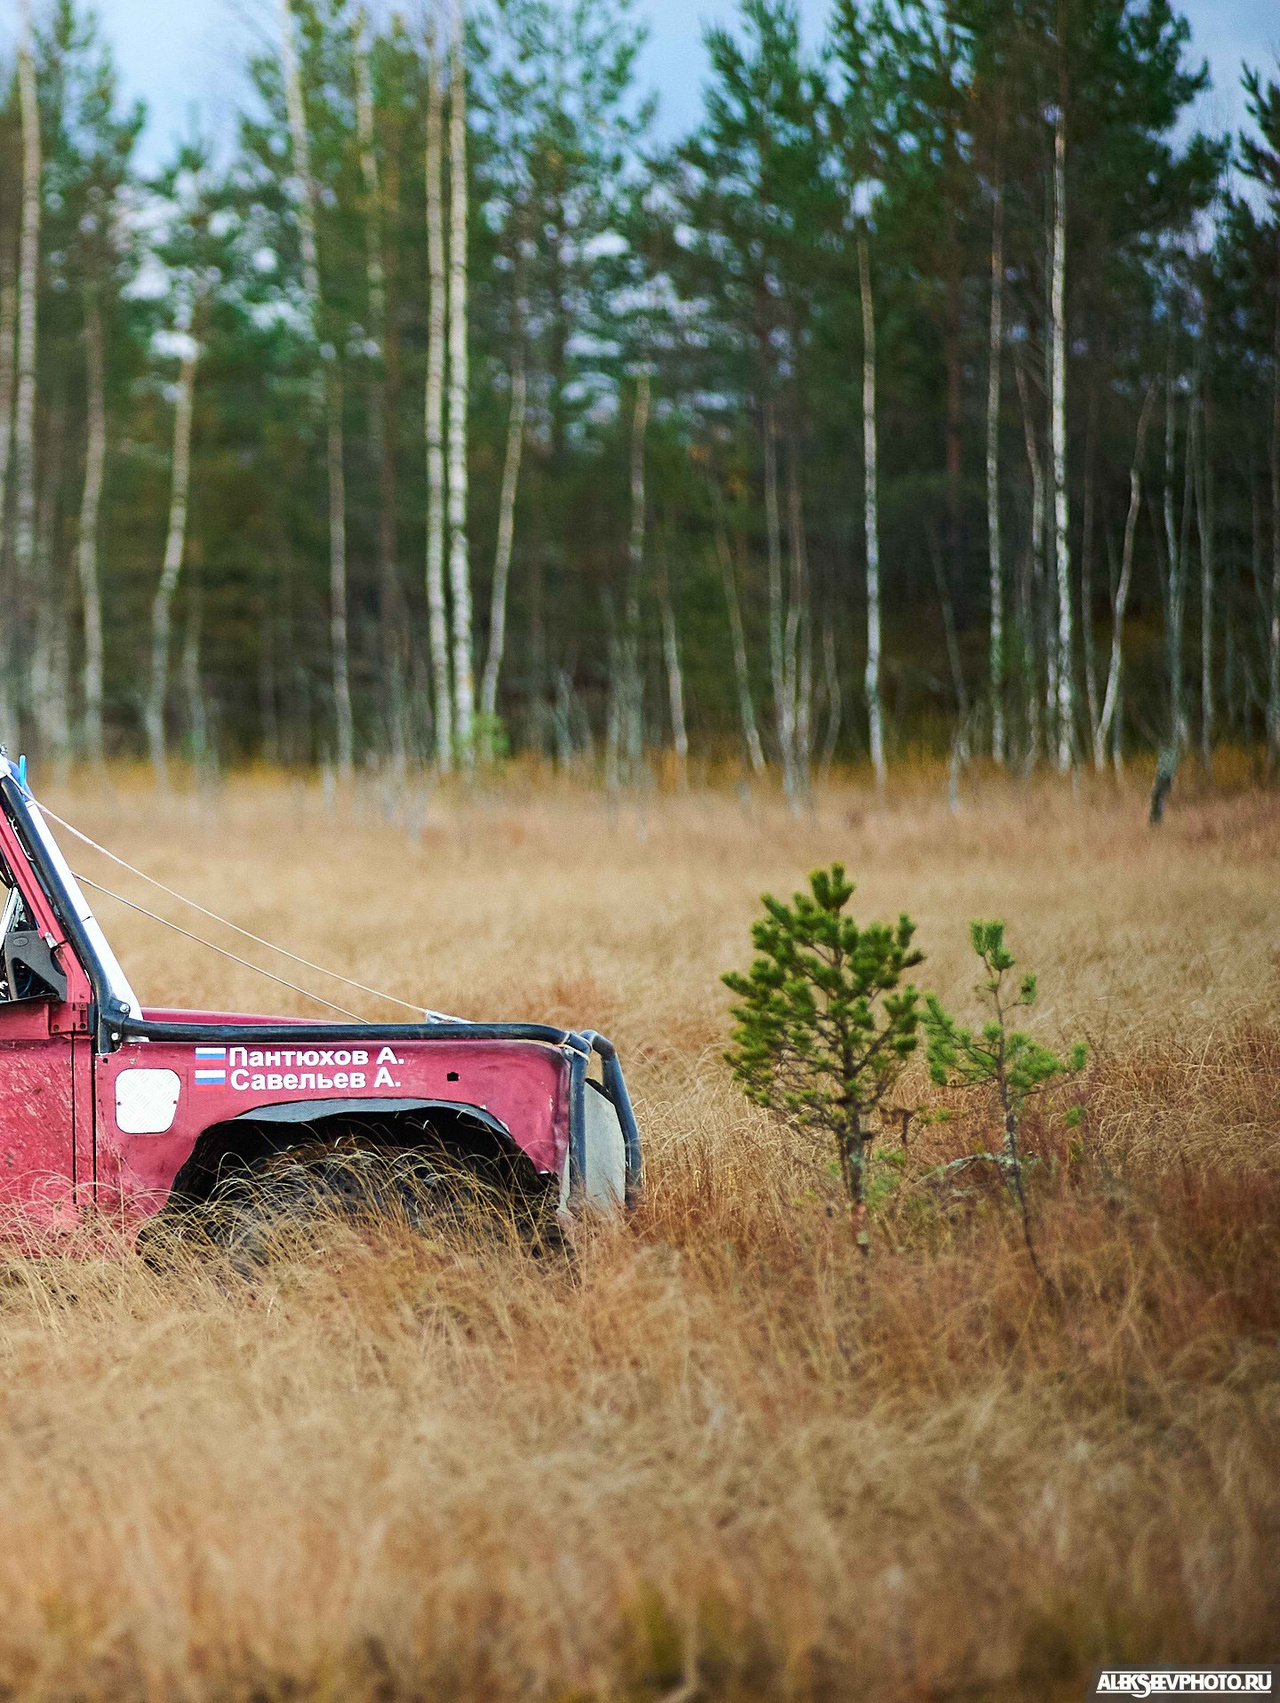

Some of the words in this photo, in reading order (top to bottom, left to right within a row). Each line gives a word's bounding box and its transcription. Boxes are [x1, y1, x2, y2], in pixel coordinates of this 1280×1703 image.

[229, 1046, 369, 1067] Пантюхов
[376, 1046, 405, 1065] А.
[230, 1069, 366, 1091] Савельев
[374, 1066, 402, 1088] А.
